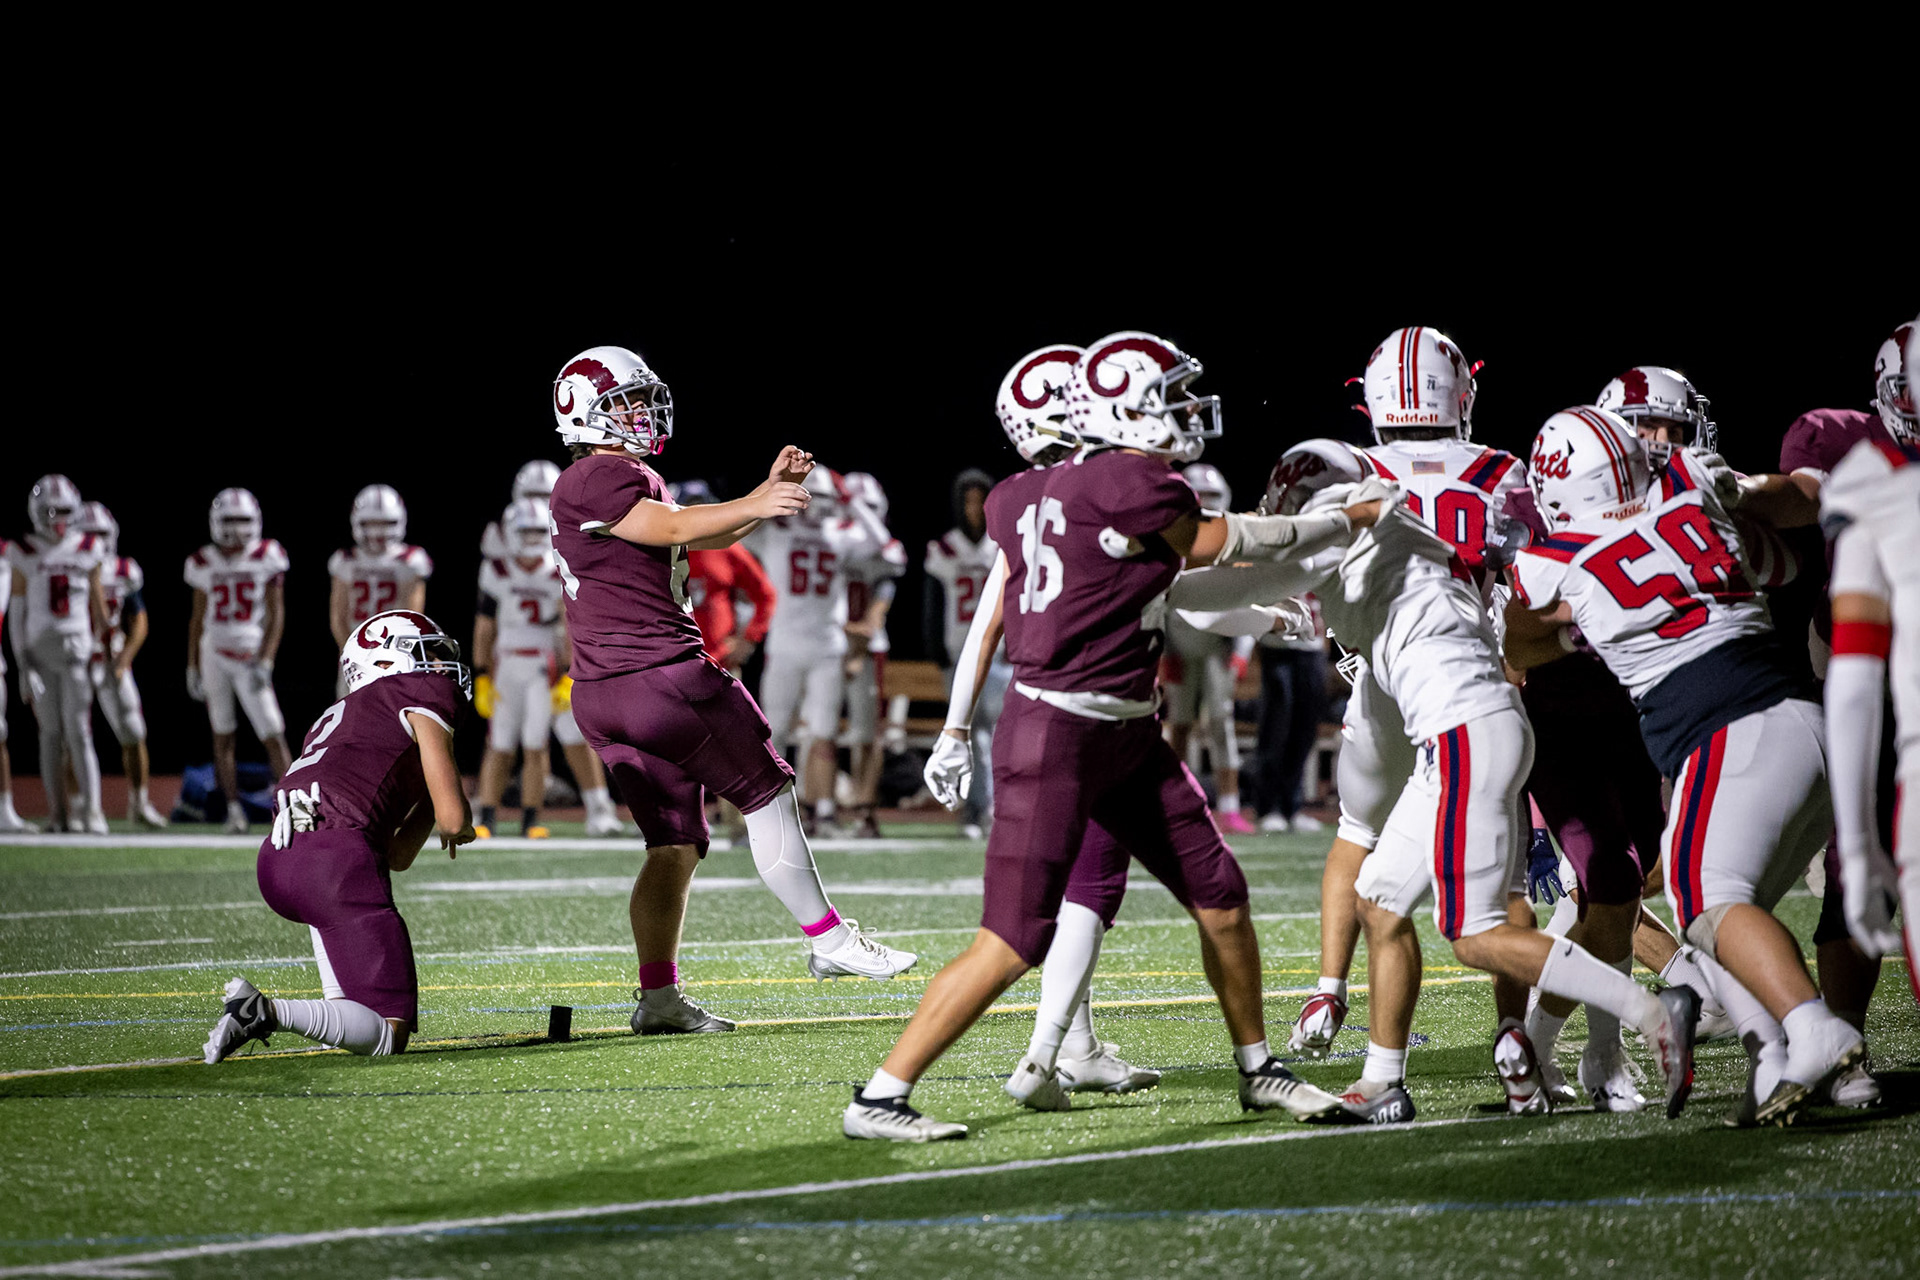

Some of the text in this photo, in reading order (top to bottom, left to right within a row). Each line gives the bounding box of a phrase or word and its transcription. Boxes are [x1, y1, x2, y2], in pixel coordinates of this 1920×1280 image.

[1386, 413, 1438, 423] Riddell
[790, 550, 836, 595] 65
[1016, 495, 1066, 614] 16
[1580, 503, 1756, 638] 58
[213, 582, 254, 621] 25
[353, 581, 397, 620] 22
[956, 576, 988, 621] 2
[286, 700, 346, 777] 2
